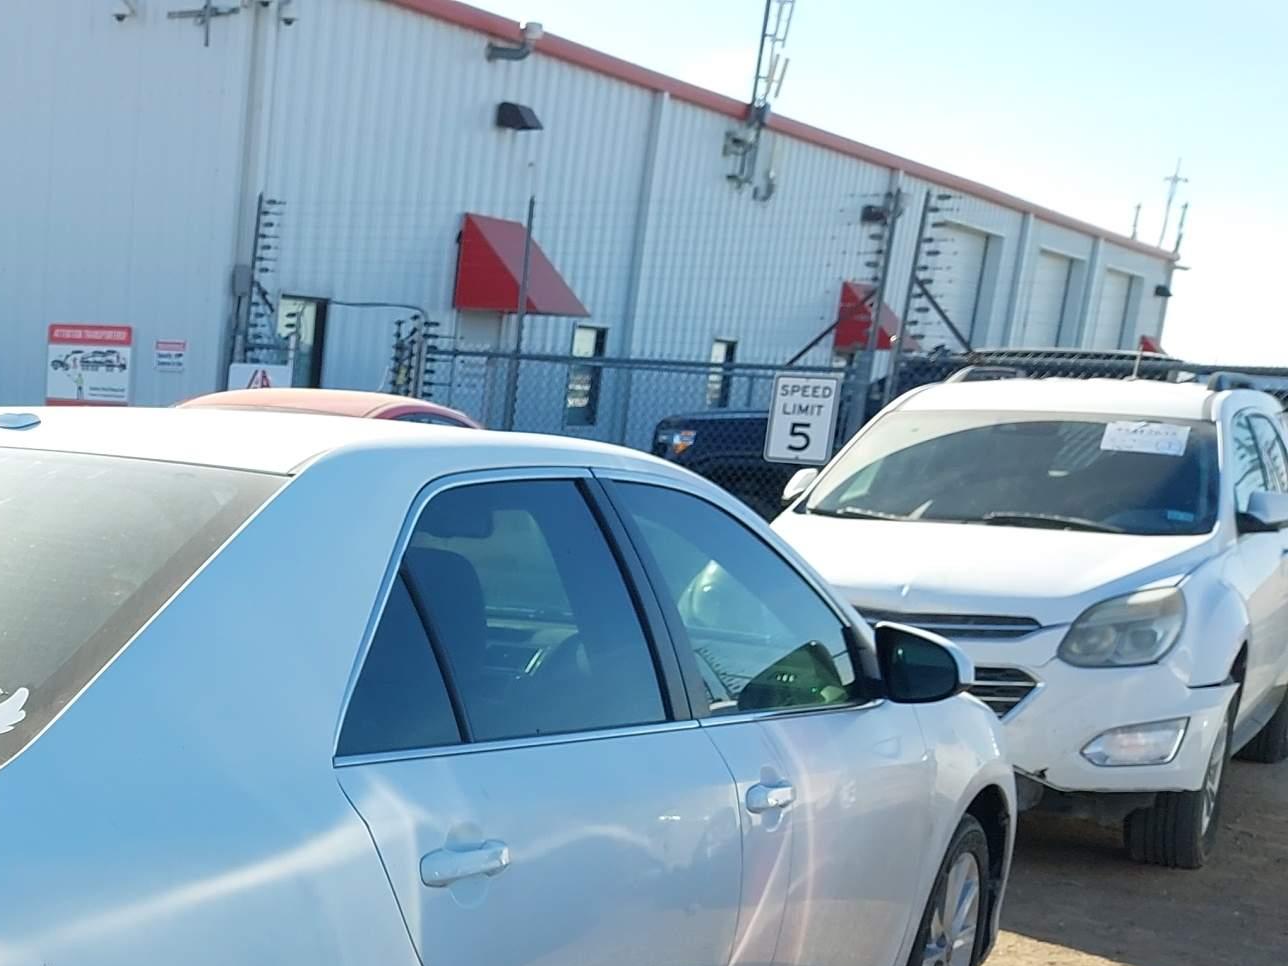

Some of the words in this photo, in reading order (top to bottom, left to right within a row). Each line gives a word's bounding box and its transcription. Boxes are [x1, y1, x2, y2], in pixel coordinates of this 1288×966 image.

[780, 384, 832, 398] SPEED
[782, 403, 824, 416] LIMIT
[787, 422, 811, 452] 5
